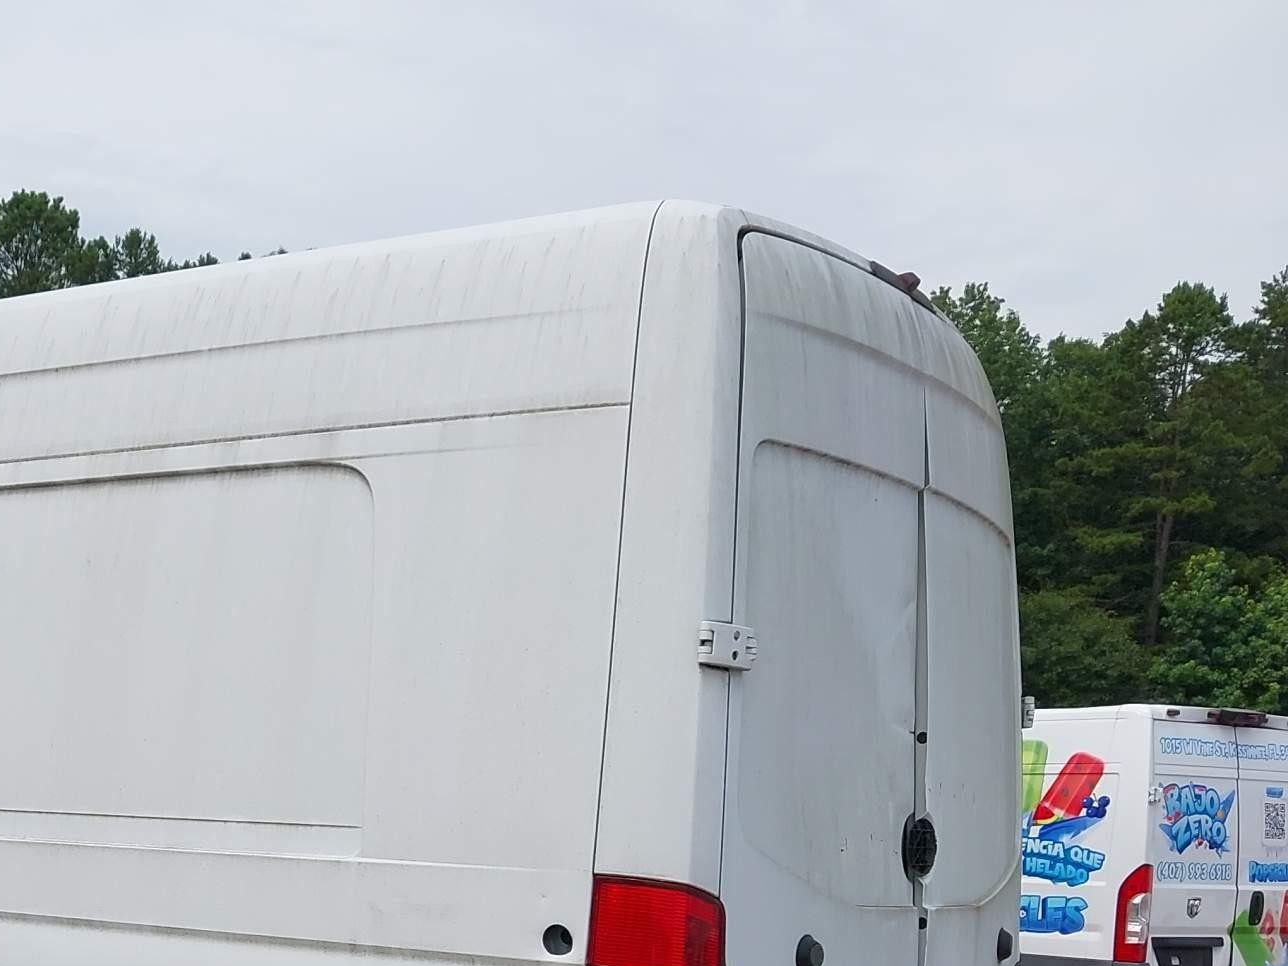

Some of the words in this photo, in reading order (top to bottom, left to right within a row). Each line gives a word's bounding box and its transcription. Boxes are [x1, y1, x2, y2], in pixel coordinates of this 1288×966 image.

[1160, 737, 1182, 755] 1015
[1163, 784, 1220, 818] BAJO
[1172, 814, 1226, 854] ZERO
[1070, 846, 1105, 868] QUE
[1025, 857, 1089, 884] HELADO
[1157, 861, 1186, 882] (407)
[1188, 862, 1208, 881] 993
[1209, 863, 1232, 881] 6918
